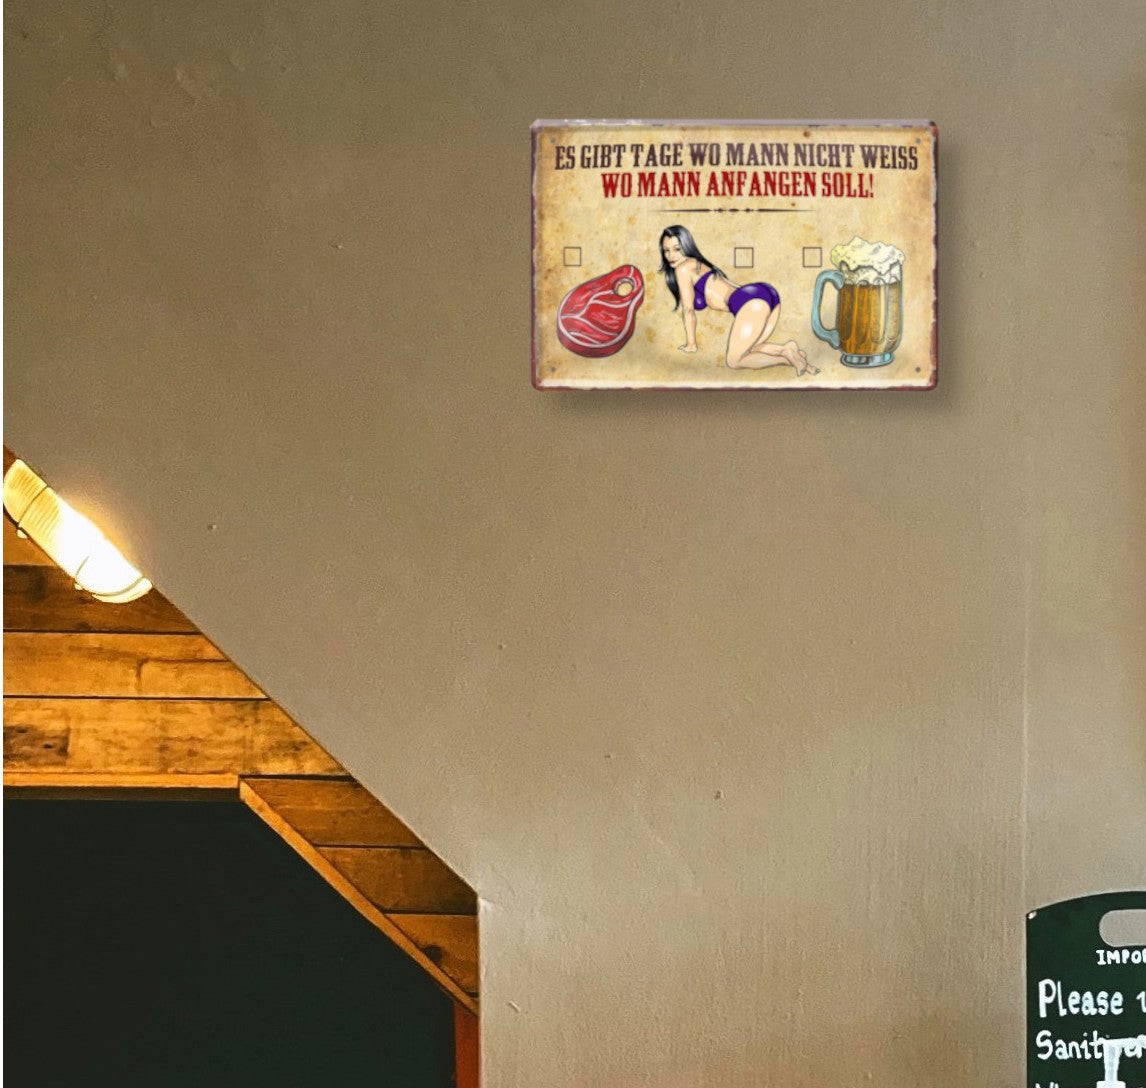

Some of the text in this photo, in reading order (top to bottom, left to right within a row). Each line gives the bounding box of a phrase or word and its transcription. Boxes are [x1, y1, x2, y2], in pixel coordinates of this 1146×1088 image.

[554, 143, 918, 170] ES GIBT TAGE WO MANN NICHT WEISS
[601, 171, 874, 198] WO MANN ANFANGEN SOLL!
[1038, 978, 1124, 1018] Please
